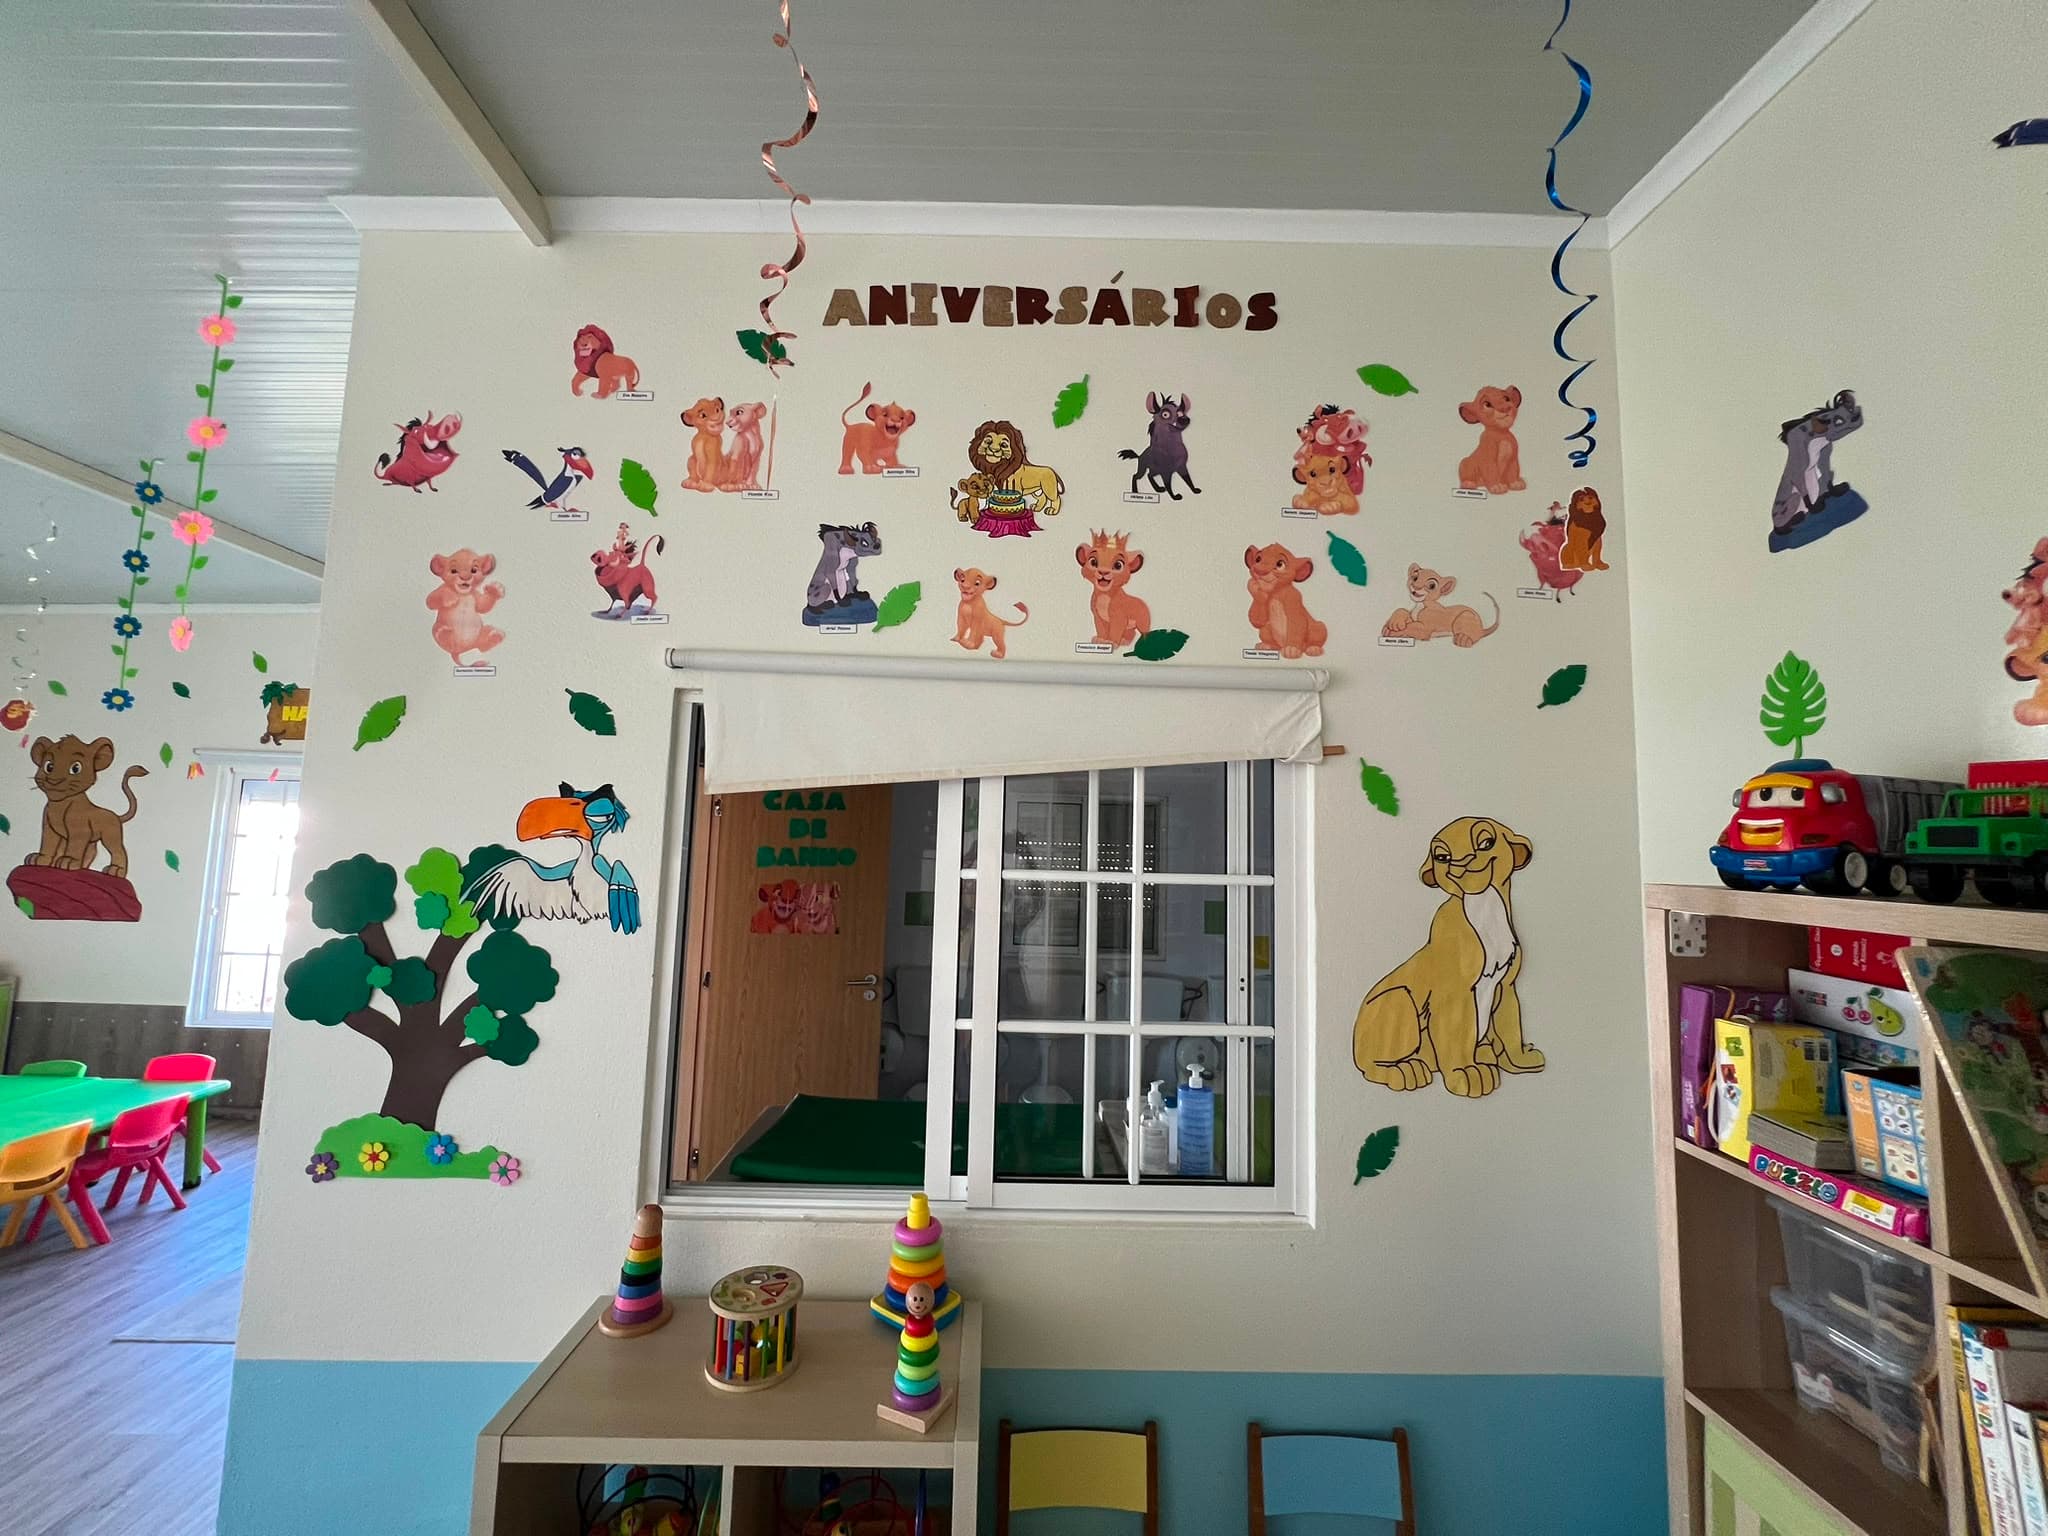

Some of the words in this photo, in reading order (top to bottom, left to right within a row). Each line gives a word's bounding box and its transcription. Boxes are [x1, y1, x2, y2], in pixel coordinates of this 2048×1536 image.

[822, 270, 1278, 331] ANIVERSÁRIOS
[763, 791, 846, 811] CASA
[789, 818, 827, 838] DE
[1971, 1377, 1995, 1438] PANDA
